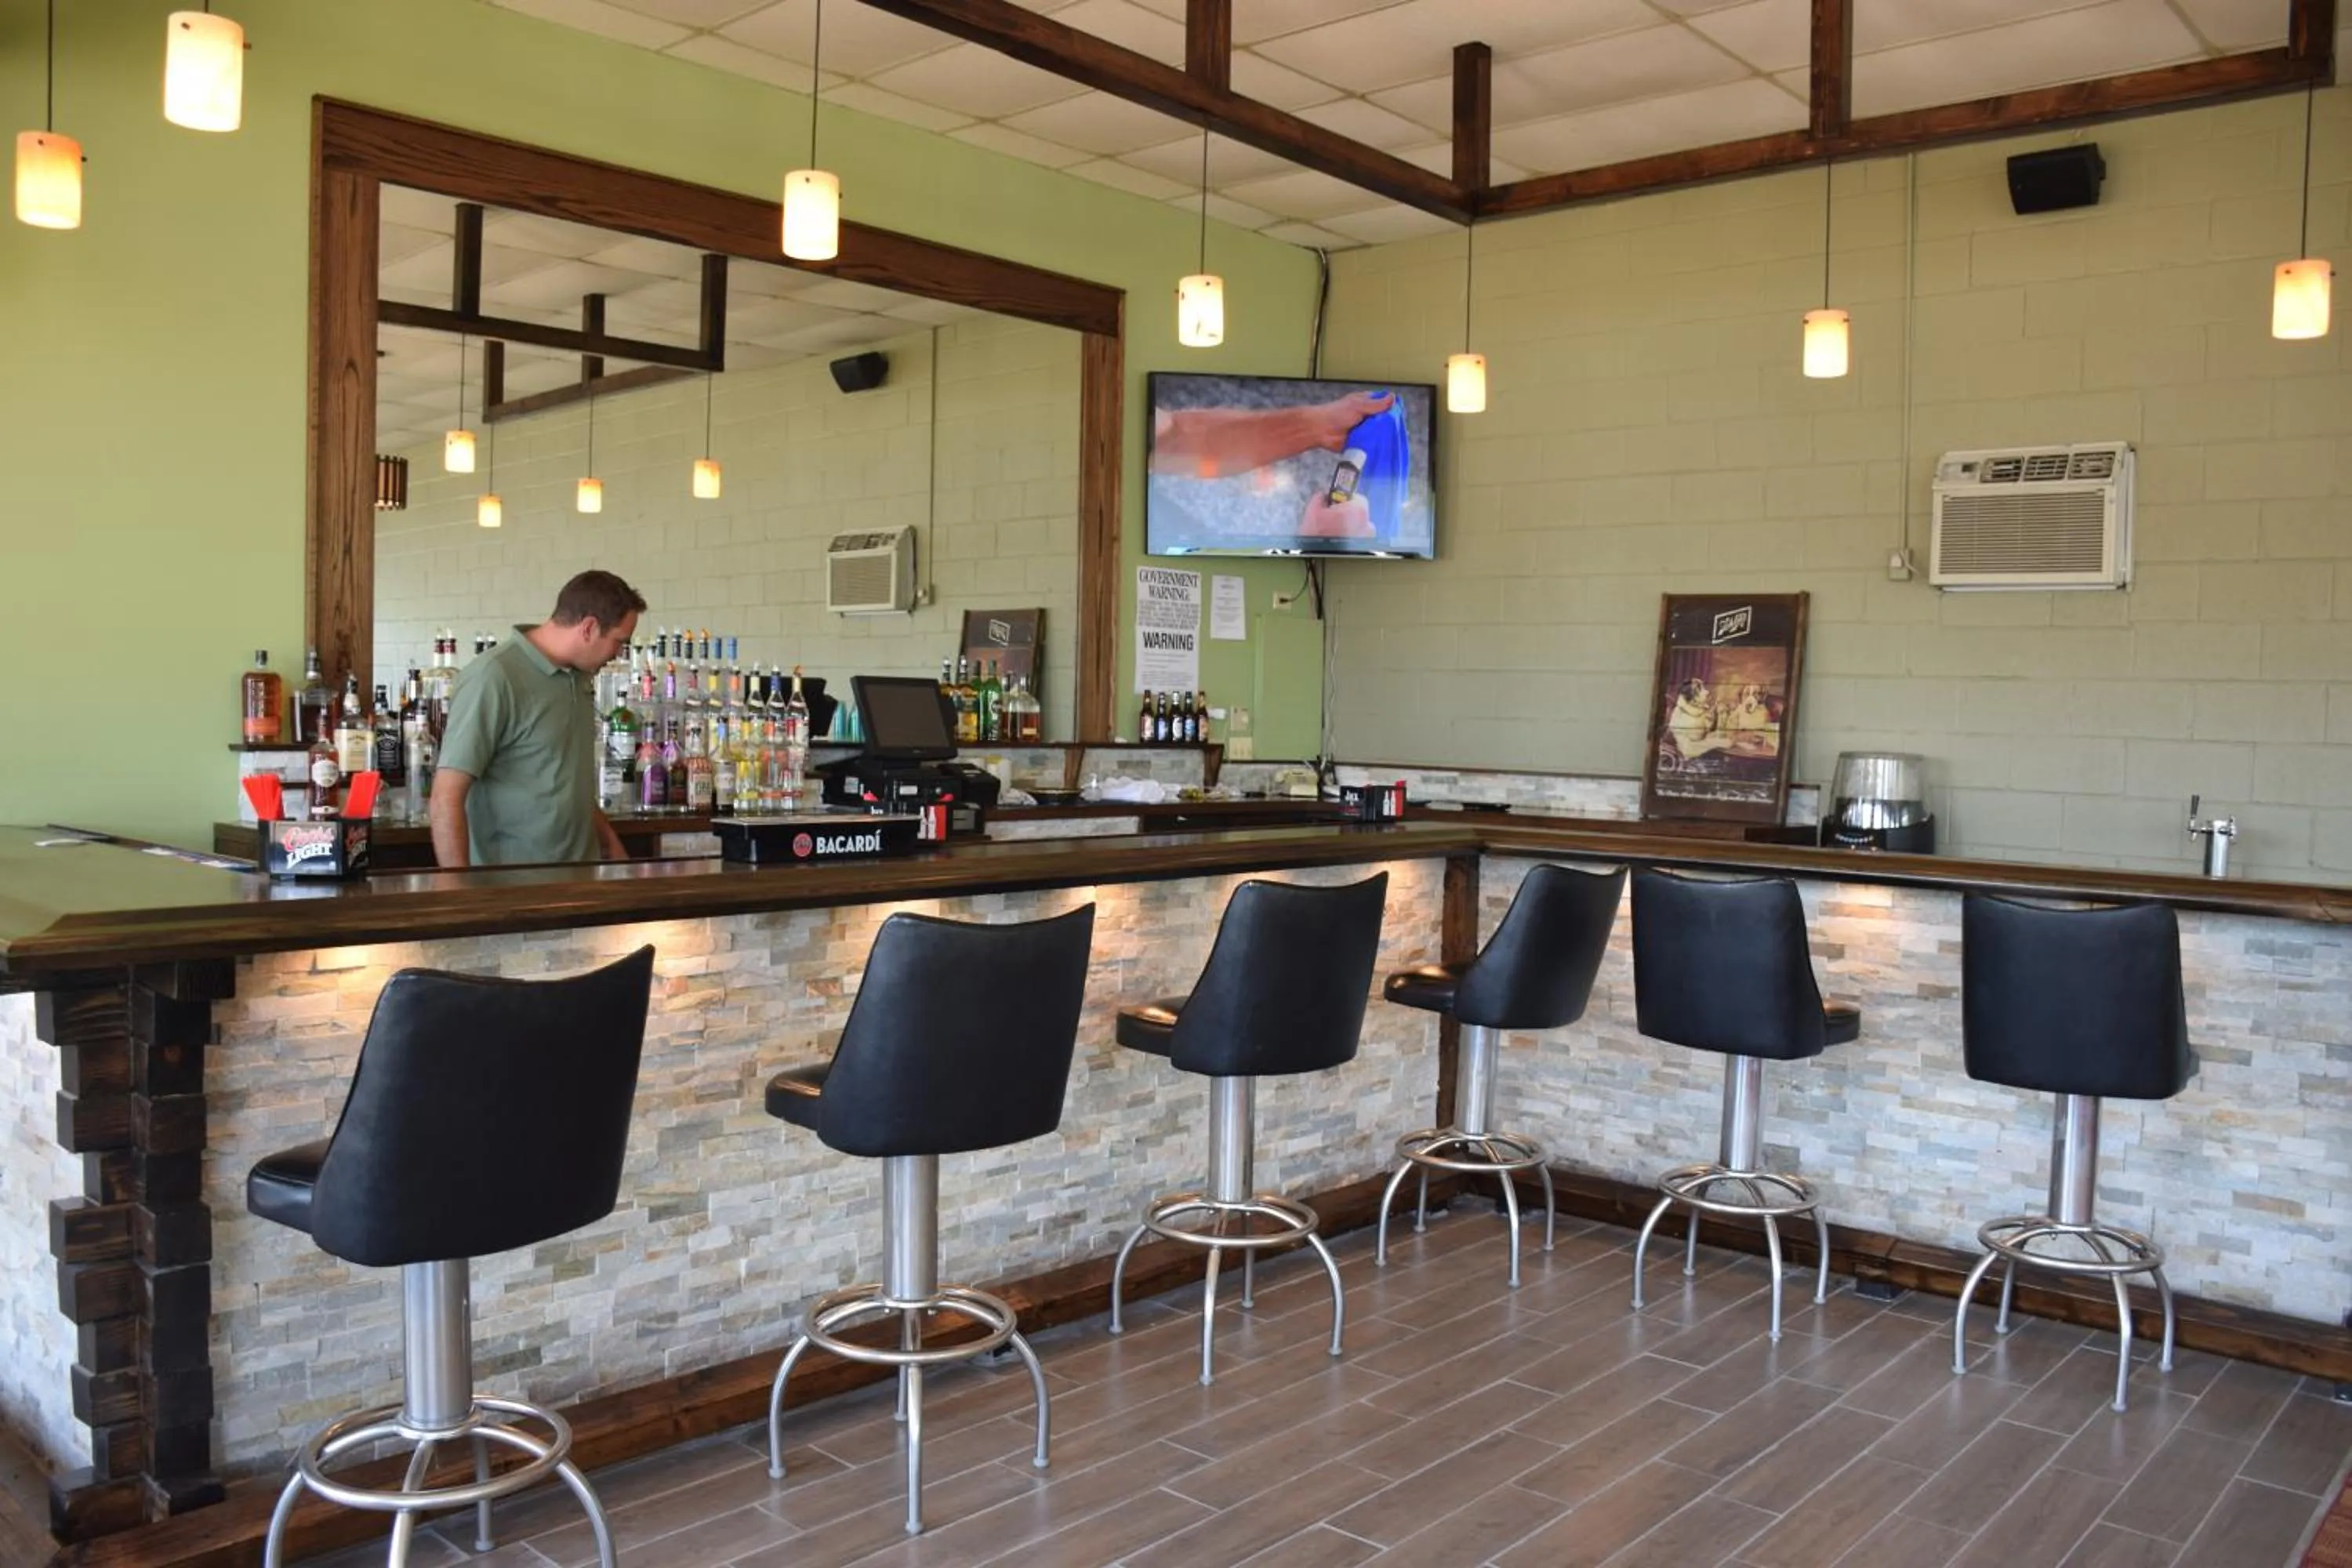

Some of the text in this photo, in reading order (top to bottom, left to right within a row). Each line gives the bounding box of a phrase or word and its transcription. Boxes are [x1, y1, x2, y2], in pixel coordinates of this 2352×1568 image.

[1139, 569, 1199, 588] GOVERNMENT
[1142, 631, 1194, 652] WARNING
[816, 829, 882, 855] BACARDÍ
[286, 842, 333, 870] LIGHT
